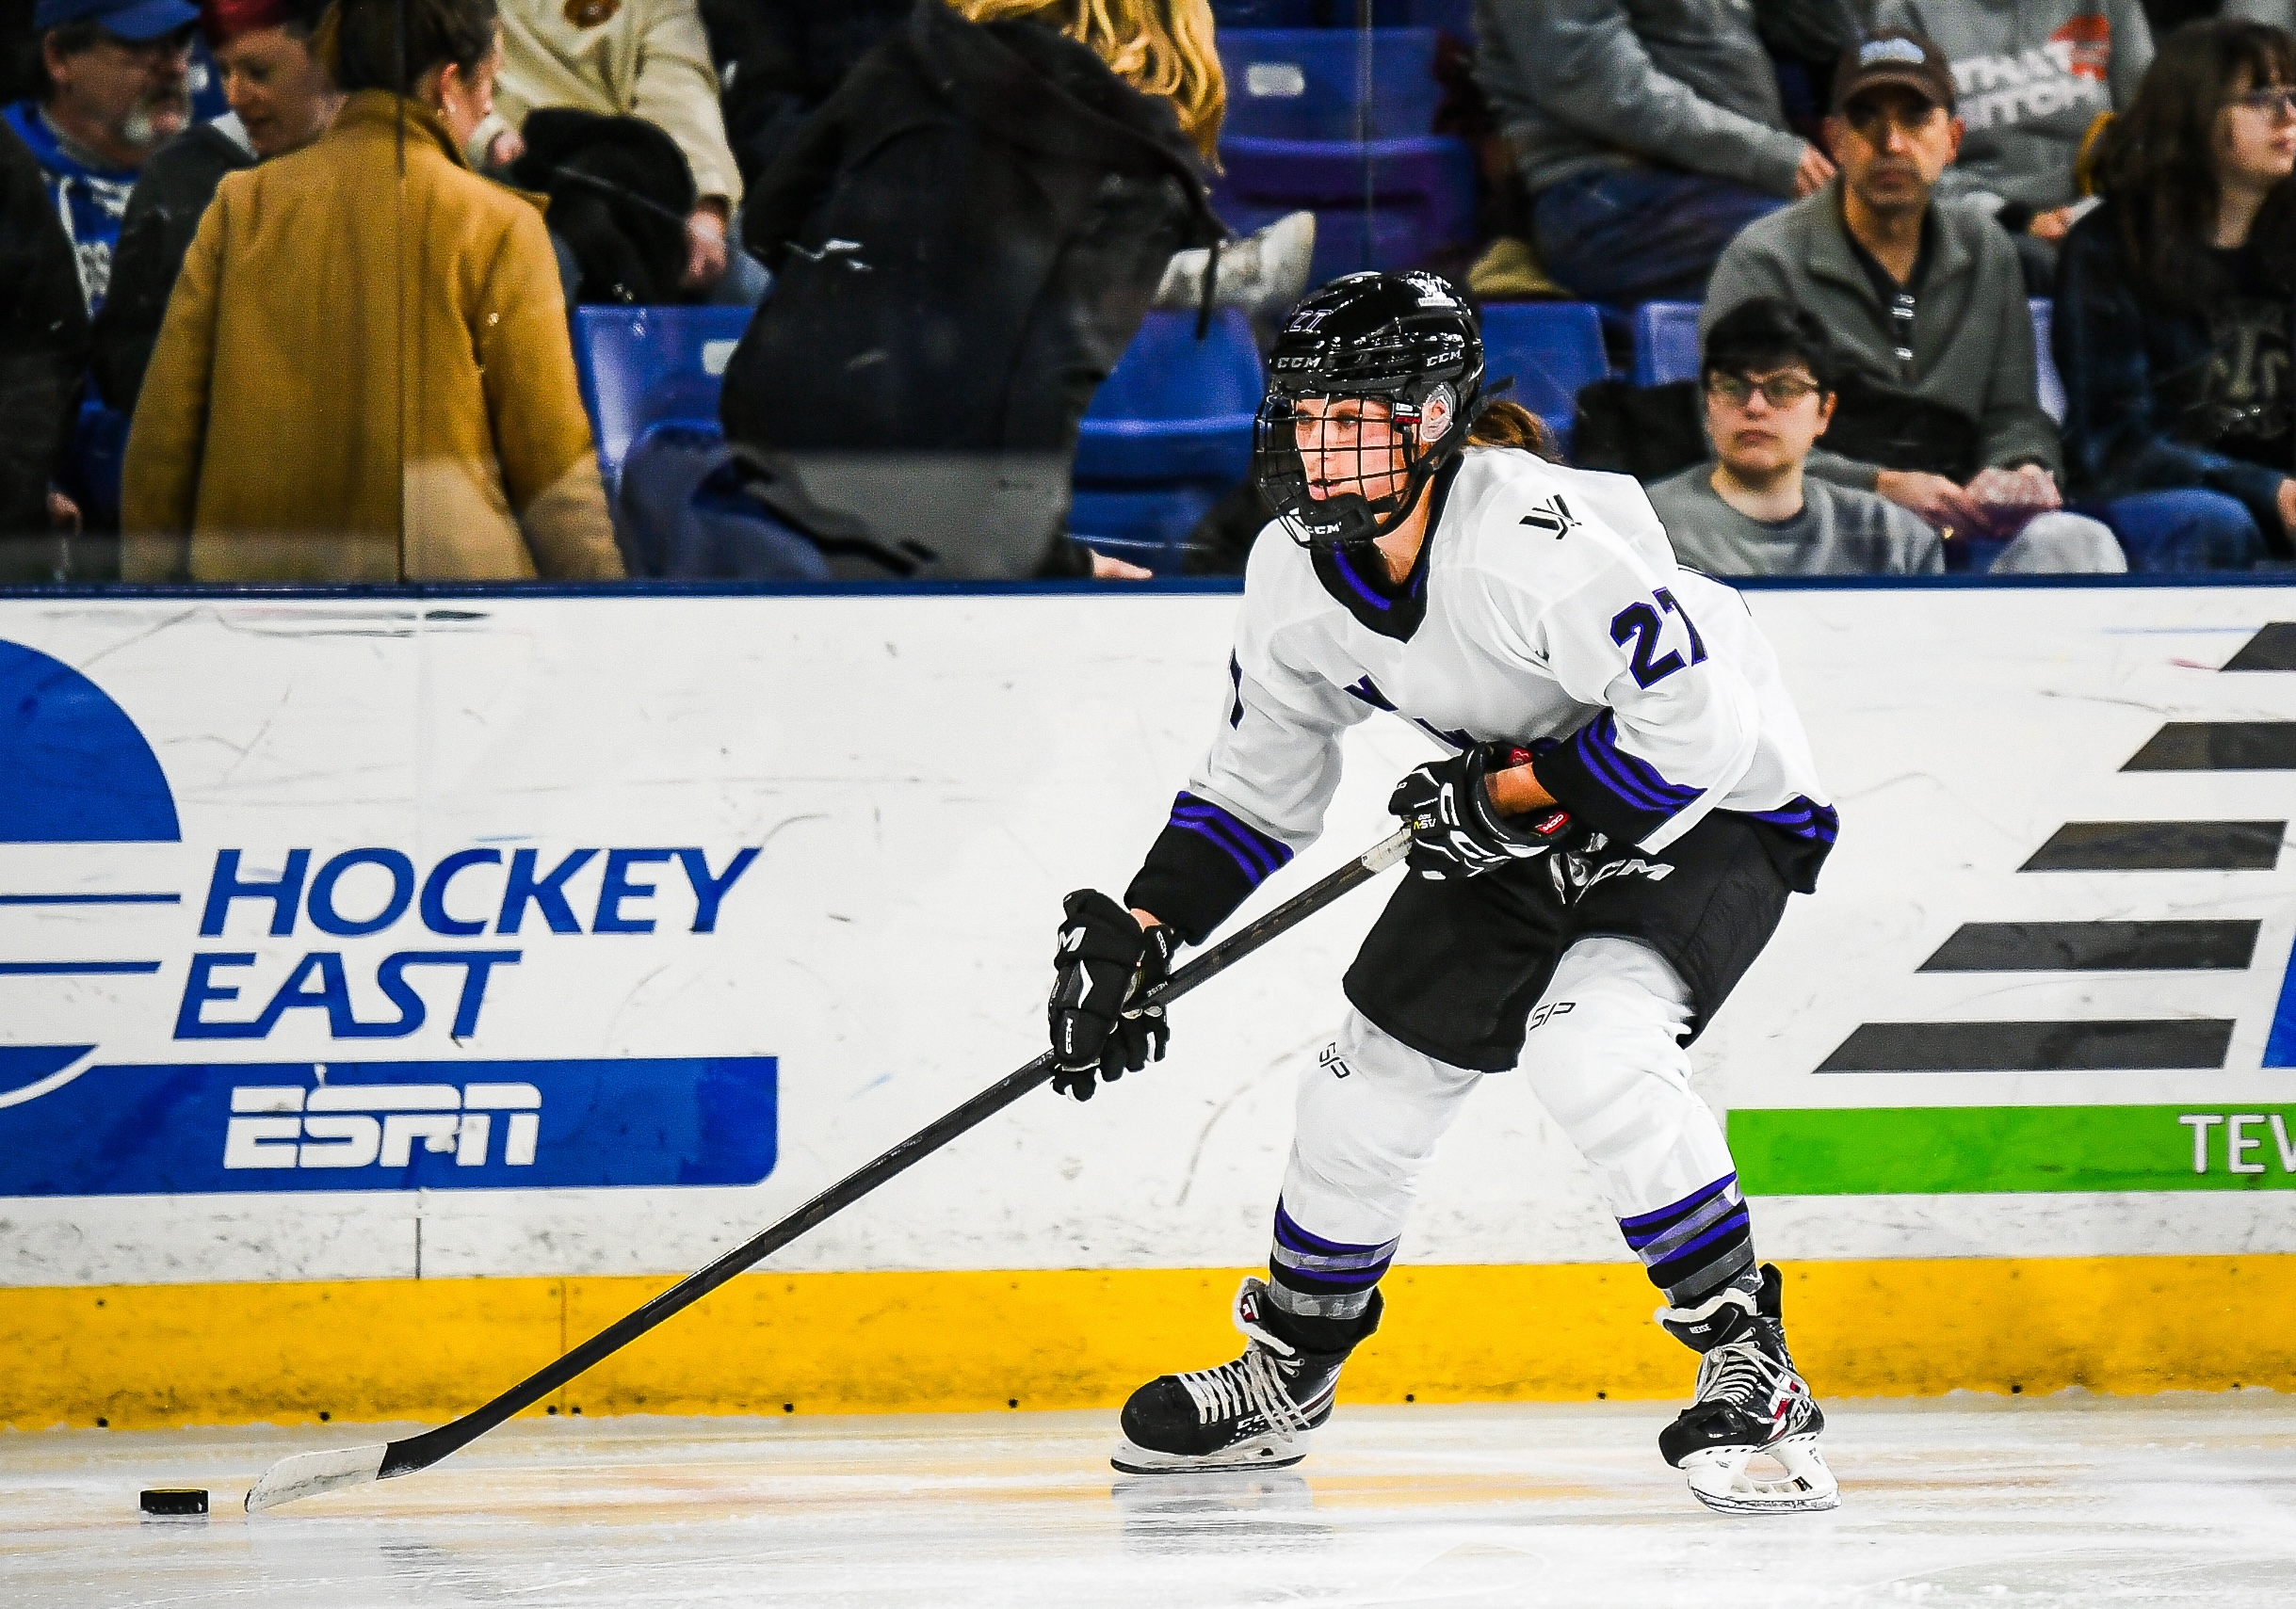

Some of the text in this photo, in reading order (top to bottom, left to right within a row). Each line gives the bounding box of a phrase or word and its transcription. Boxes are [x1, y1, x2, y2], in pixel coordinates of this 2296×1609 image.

[1288, 310, 1332, 332] 27
[1277, 357, 1321, 368] CCM
[1426, 348, 1463, 366] CCM
[1304, 523, 1340, 535] CCM
[1609, 587, 1709, 690] 27
[199, 847, 764, 937] HOCKEY
[172, 949, 524, 1040] EAST
[223, 1082, 543, 1169] ESPN
